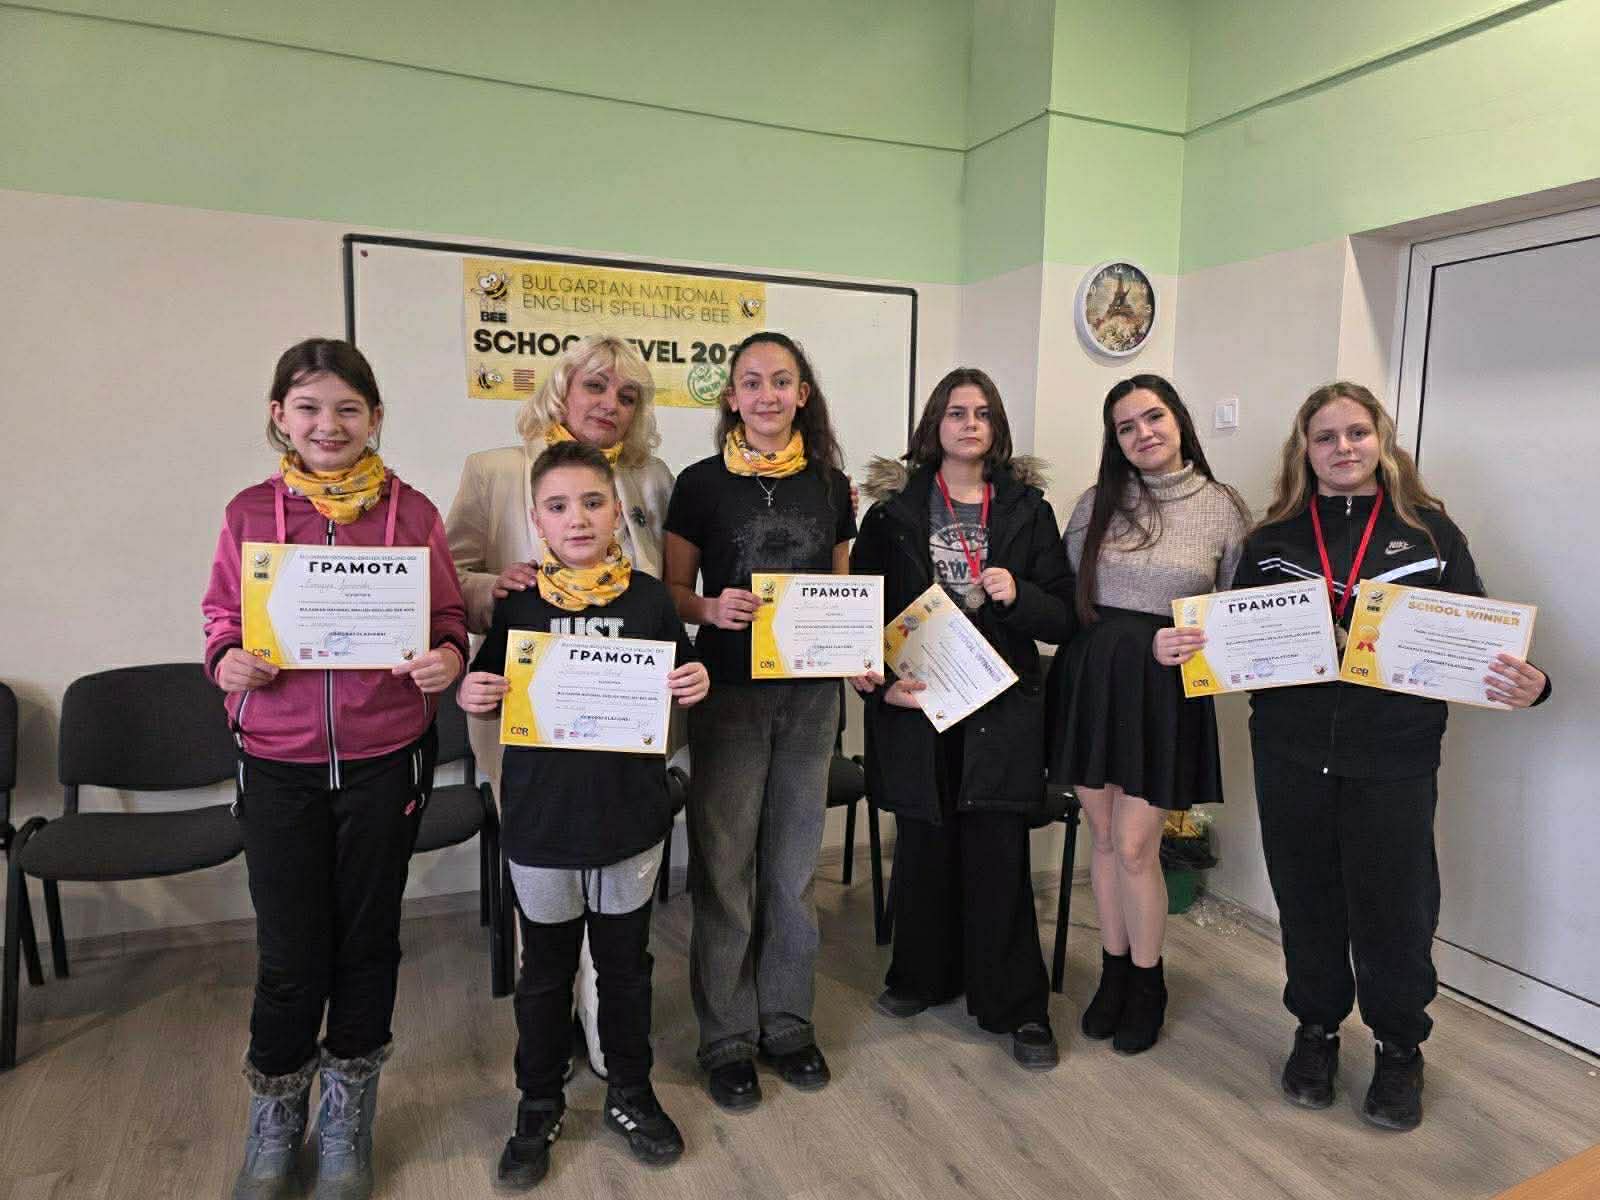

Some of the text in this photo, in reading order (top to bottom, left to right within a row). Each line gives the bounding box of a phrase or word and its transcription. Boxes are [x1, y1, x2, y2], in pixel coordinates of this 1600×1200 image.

[521, 274, 729, 305] BULGARIAN NATIONAL
[480, 311, 508, 323] BEE
[523, 294, 731, 323] ENGLISH SPELLING BEE
[691, 341, 738, 365] 20
[309, 561, 408, 575] ГРАМОТА
[802, 588, 869, 597] ГРАМОТА
[1228, 593, 1311, 614] ГРАМОТА
[1407, 601, 1462, 617] SCHOOL
[1465, 609, 1521, 627] WINNER
[569, 649, 656, 666] ГРАМОТА
